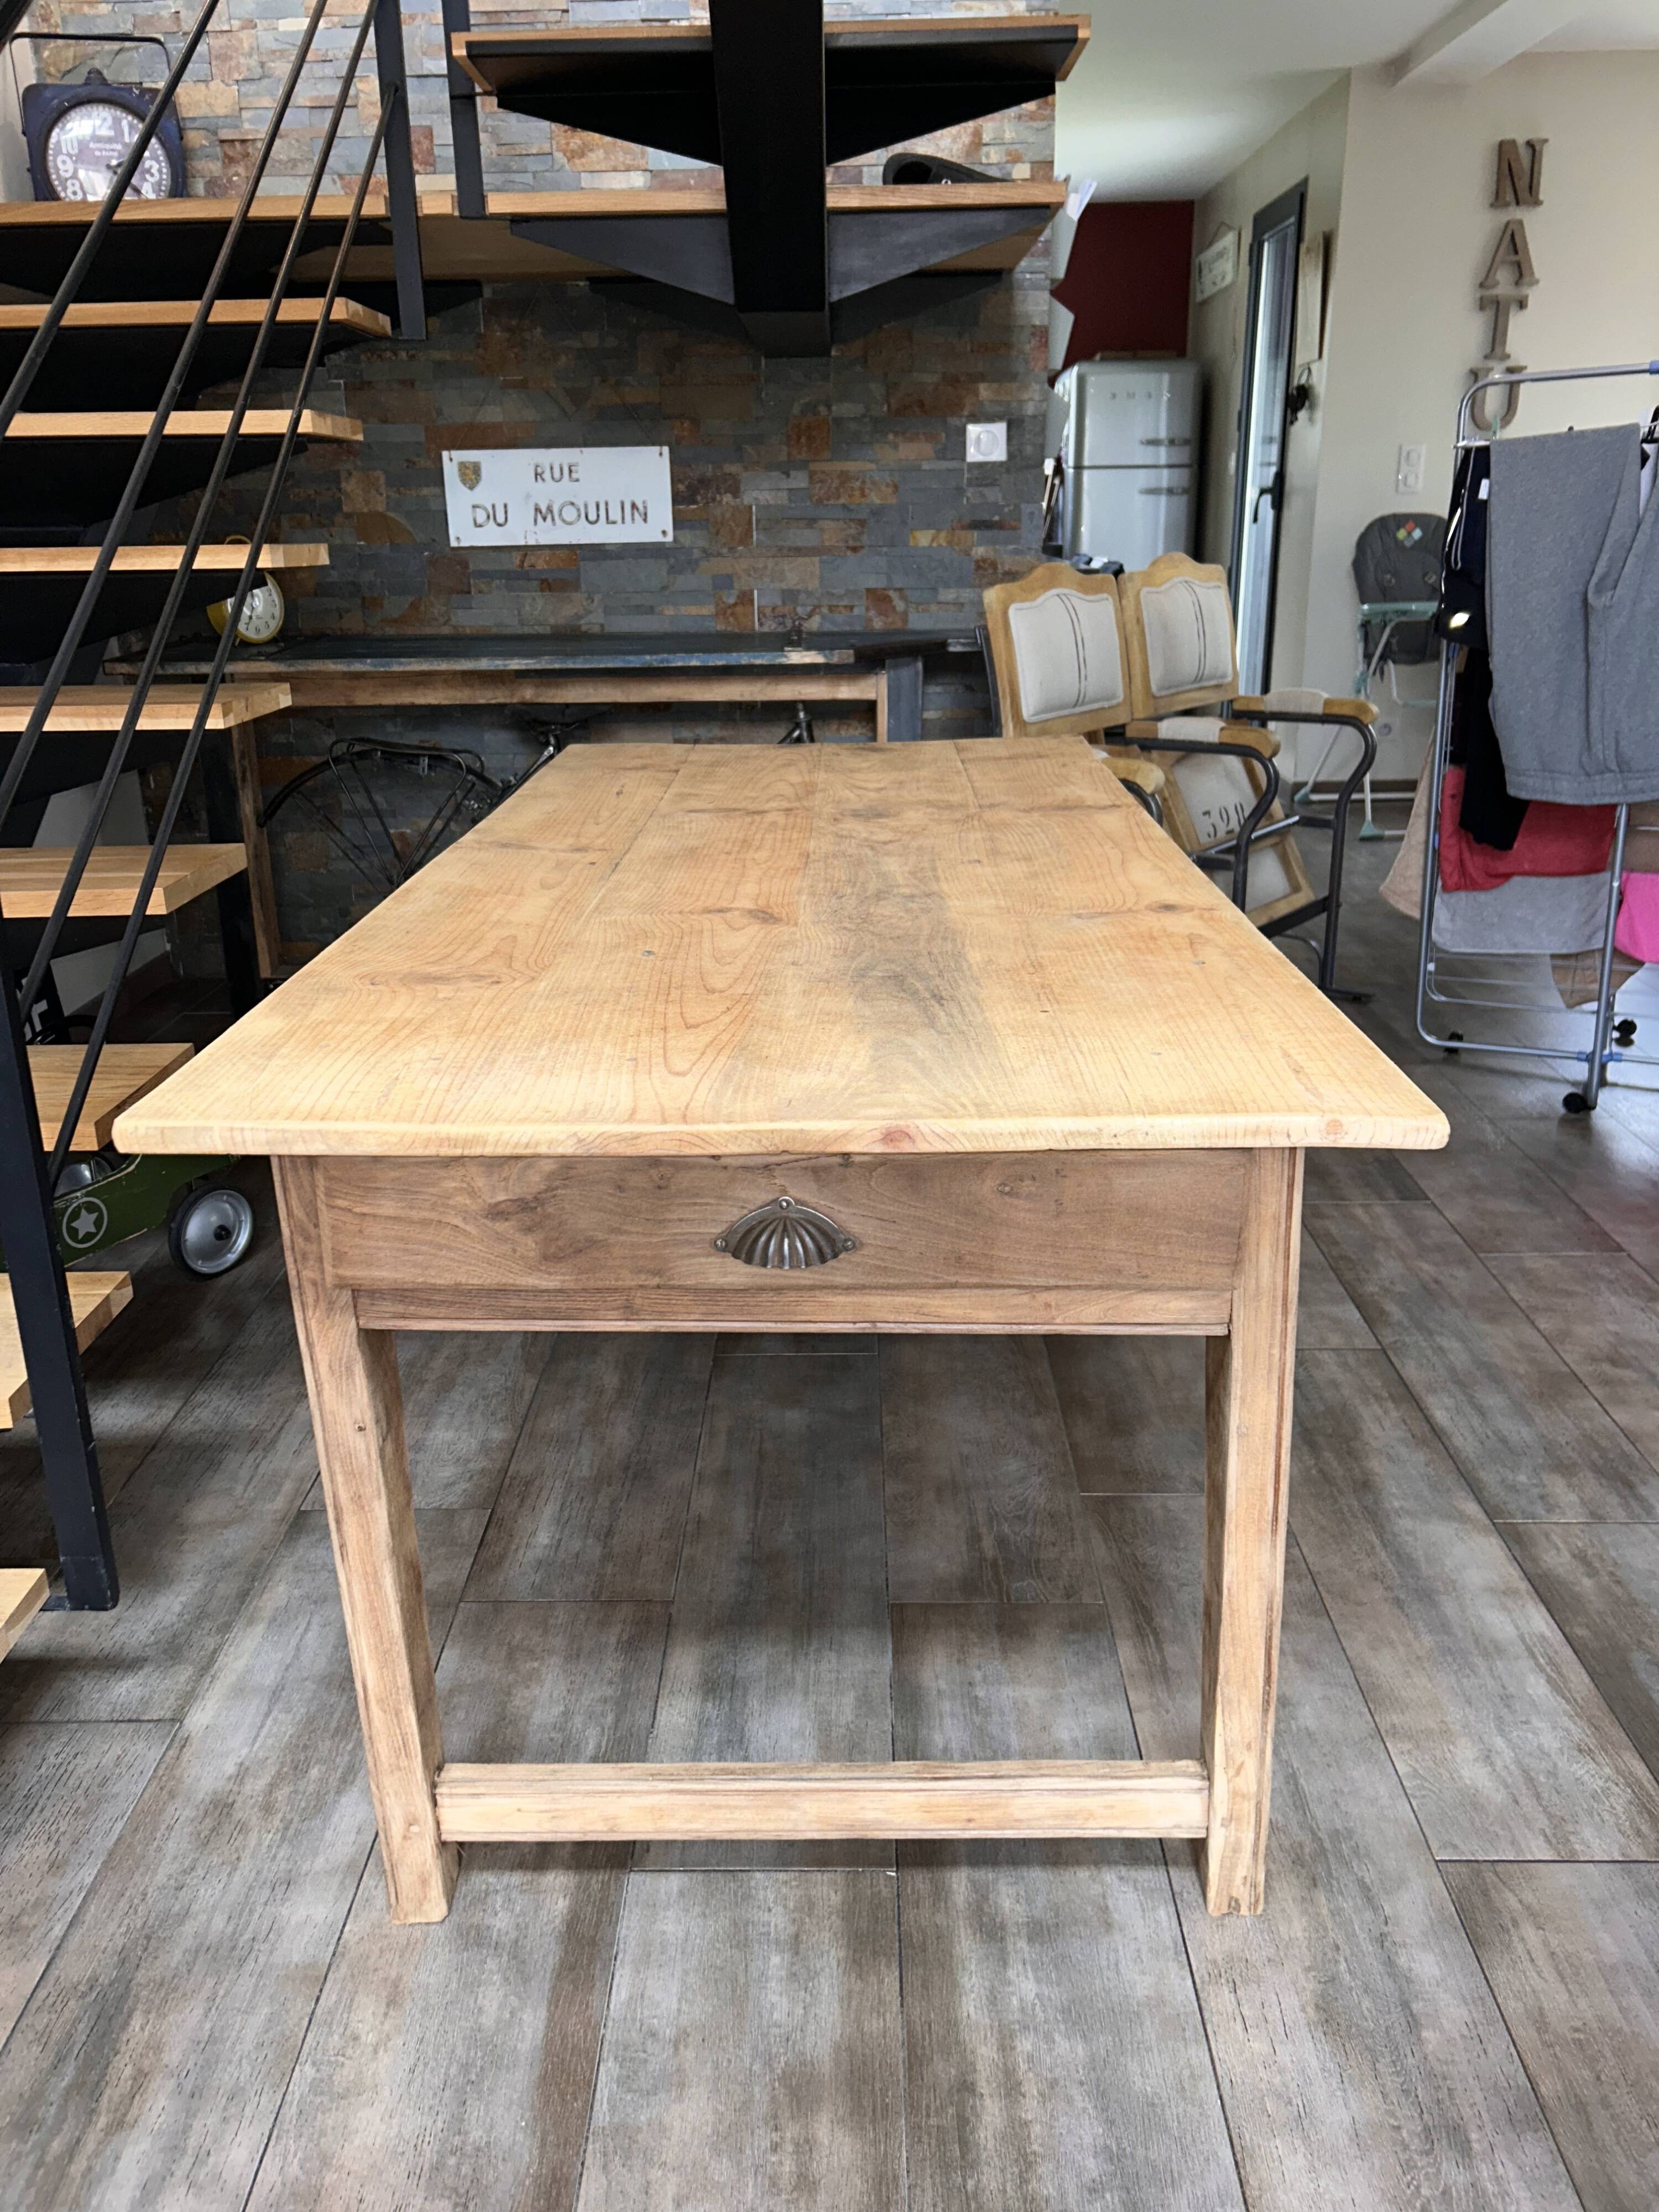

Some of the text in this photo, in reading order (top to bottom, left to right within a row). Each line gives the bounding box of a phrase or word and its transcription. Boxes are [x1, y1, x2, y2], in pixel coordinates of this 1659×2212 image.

[122, 119, 129, 143] 1
[57, 154, 74, 178] 9
[144, 160, 159, 183] 3
[66, 179, 83, 201] 8
[141, 181, 156, 199] 4
[534, 462, 580, 483] RUE
[471, 499, 648, 528] DU MOULIN
[255, 625, 260, 634] 6
